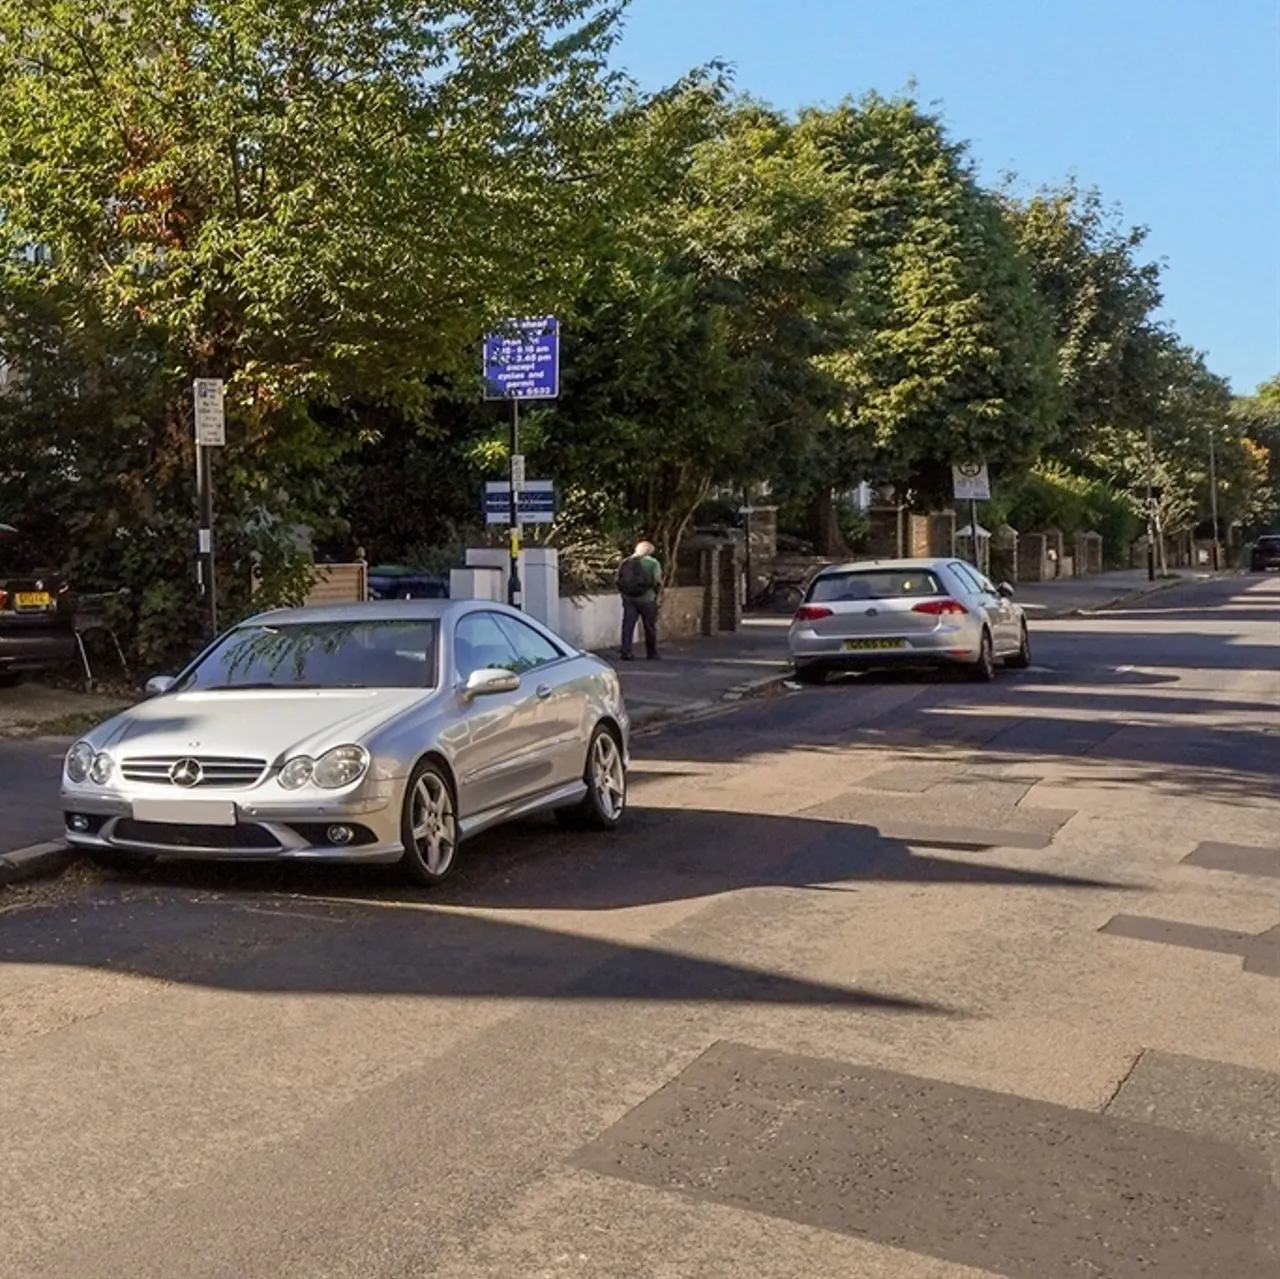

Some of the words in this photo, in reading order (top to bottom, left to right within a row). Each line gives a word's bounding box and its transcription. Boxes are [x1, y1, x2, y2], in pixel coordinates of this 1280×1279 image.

[506, 363, 535, 371] except
[498, 372, 525, 381] cycles
[528, 370, 544, 378] and
[506, 380, 535, 389] permit
